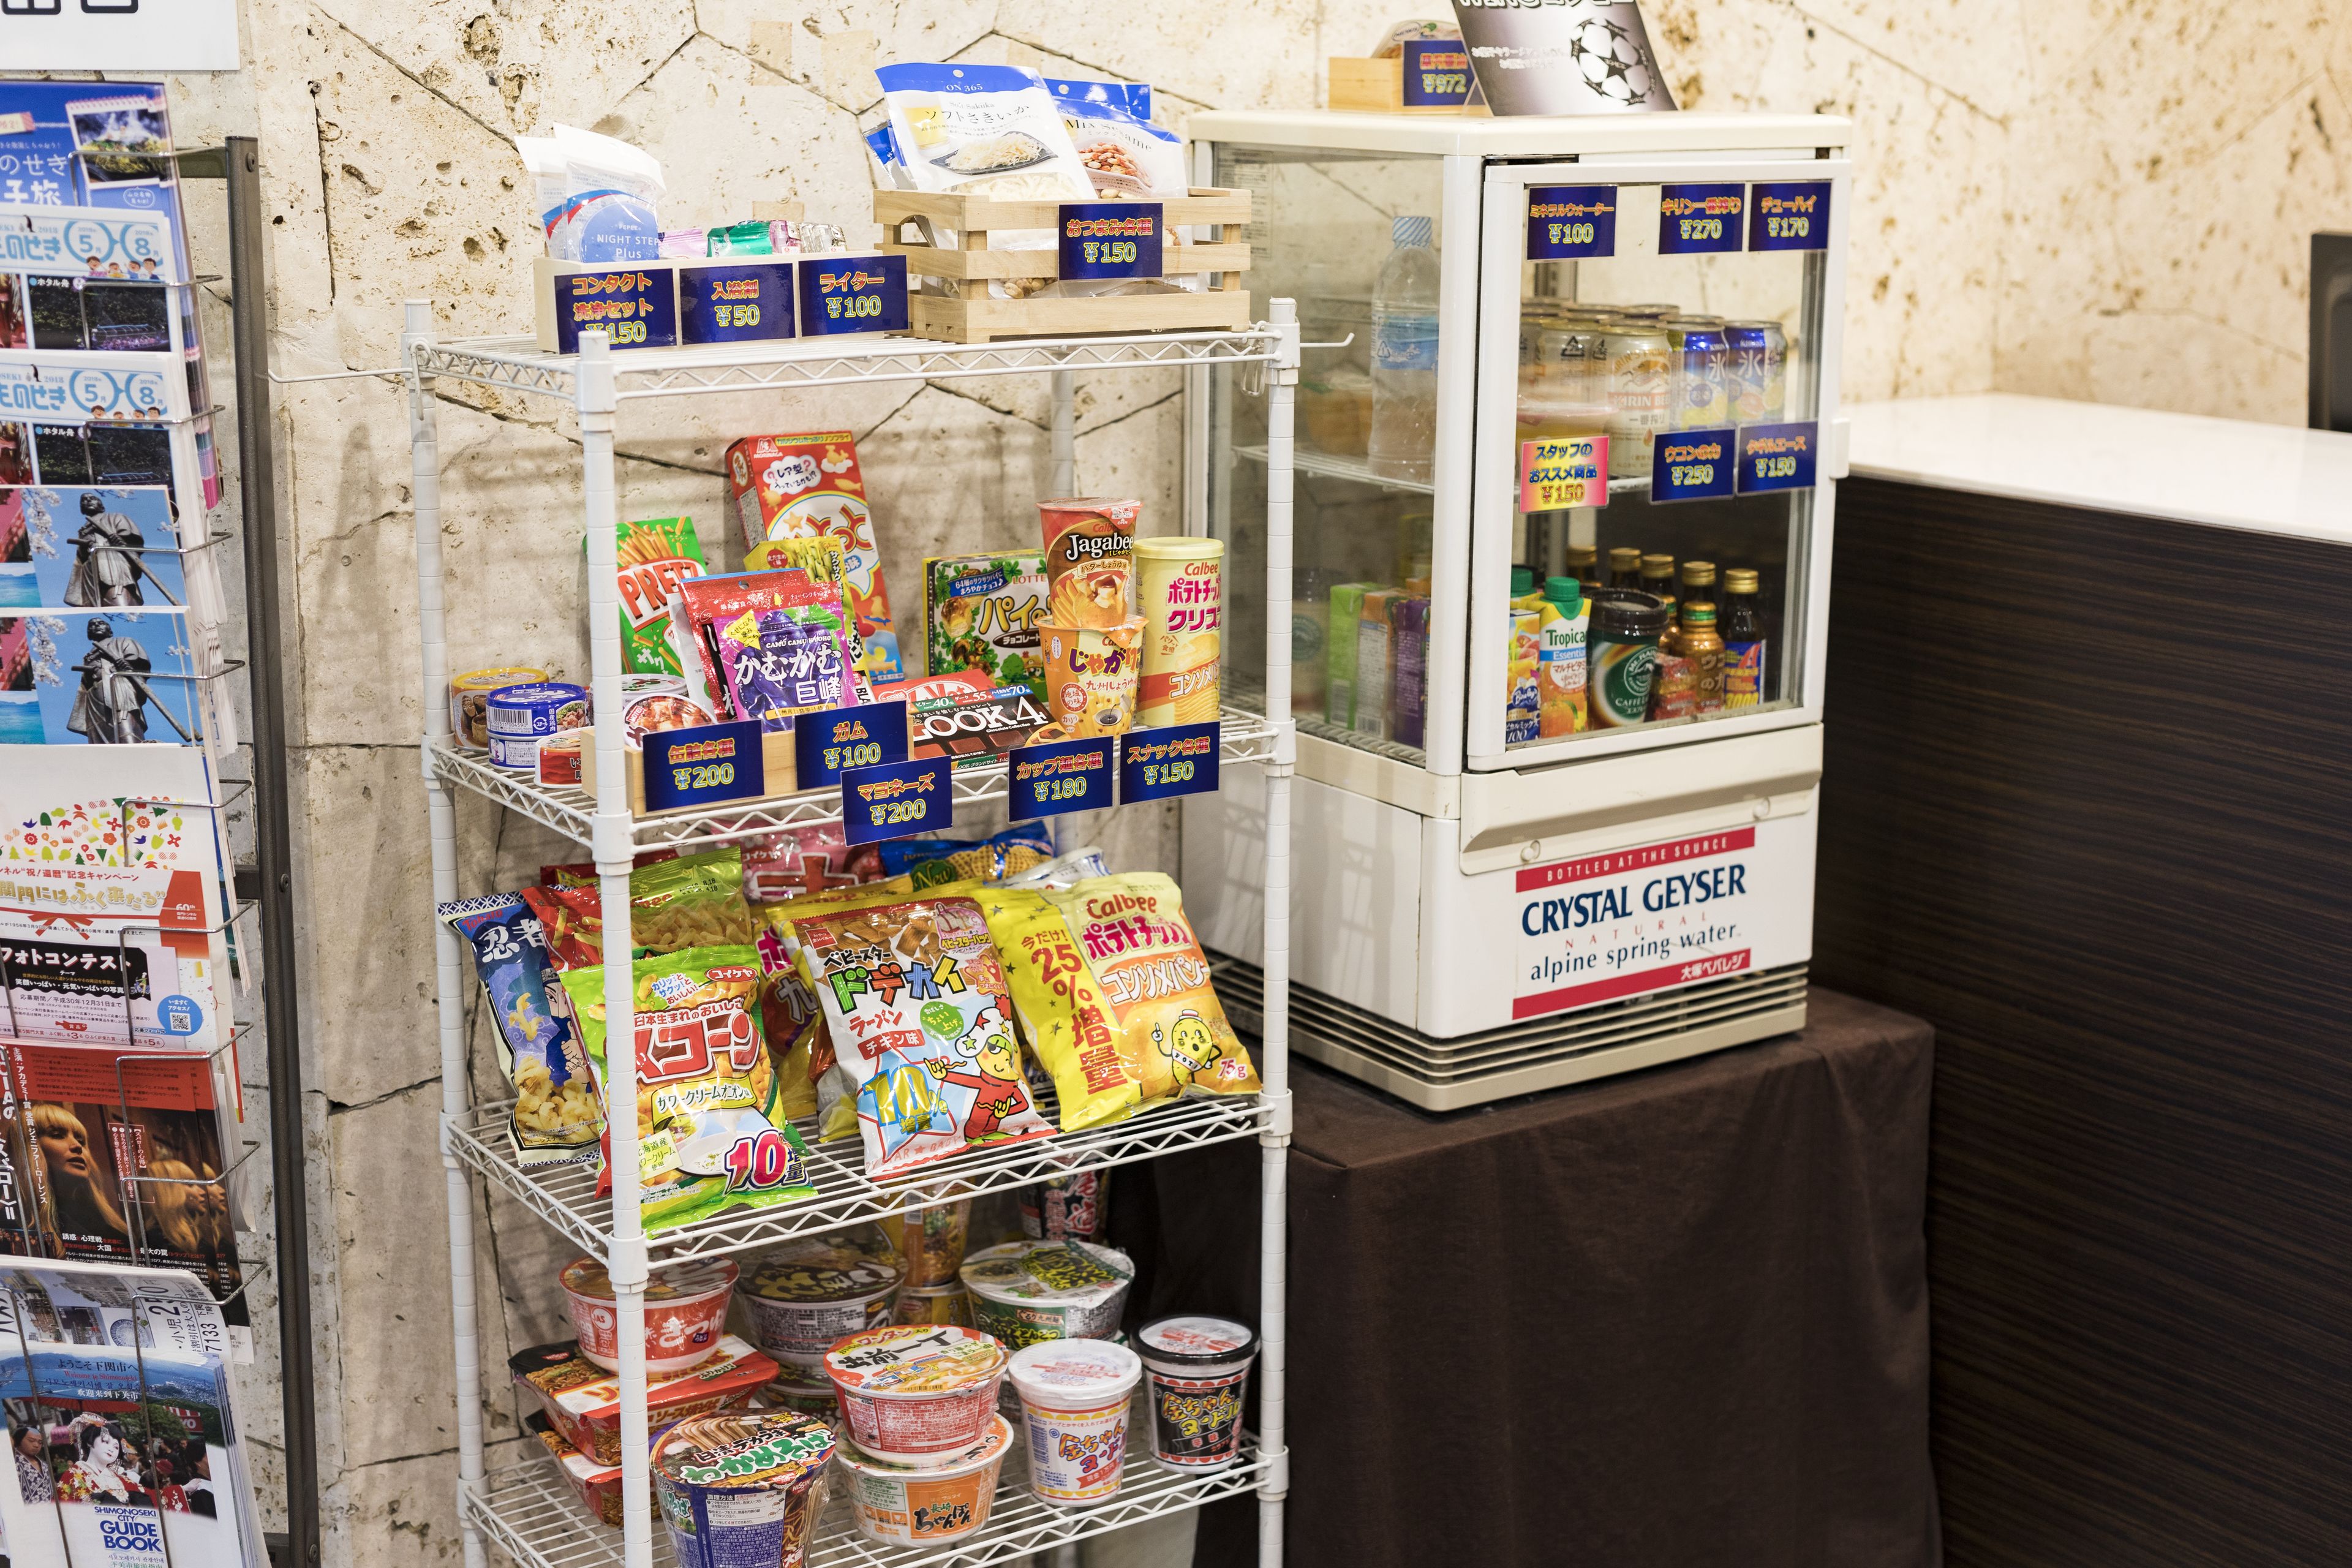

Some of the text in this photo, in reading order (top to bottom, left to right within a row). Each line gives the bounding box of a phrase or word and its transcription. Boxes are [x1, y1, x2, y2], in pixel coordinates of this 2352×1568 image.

[1529, 202, 1615, 219] ミネラルウォーター
[1761, 195, 1817, 214] チューハイ
[1066, 217, 1153, 238] おつまみ各種
[1548, 224, 1594, 244] ¥100
[1679, 219, 1722, 239] ¥270
[1767, 217, 1809, 238] ¥170
[597, 234, 659, 246] NIGHT STEP
[616, 247, 642, 258] Plus
[1084, 241, 1137, 263] ¥150
[572, 272, 652, 295] コンタクト
[711, 279, 759, 301] 入浴剤
[820, 271, 884, 293] ライター
[573, 298, 654, 322] 洗浄セット
[714, 304, 760, 327] ¥50
[826, 295, 882, 318] ¥100
[1534, 441, 1593, 461] スタッフの
[1529, 463, 1598, 483] おススメ商品
[1671, 465, 1714, 486] ¥250
[1755, 456, 1796, 478] ¥150
[1540, 483, 1585, 505] ¥150
[1066, 532, 1134, 560] Jagabee
[1012, 574, 1047, 585] LOTTE
[1184, 562, 1218, 576] Calbee
[766, 638, 786, 649] CAMU
[788, 637, 807, 647] CAMU
[733, 644, 843, 685] かむかむ
[796, 677, 842, 704] 巨峰
[913, 696, 1049, 741] LOOK 4
[832, 720, 869, 743] ガム
[668, 737, 736, 764] 缶詰各種
[823, 742, 881, 769] ¥100
[1127, 736, 1211, 764] スナック各種
[673, 763, 735, 791] ¥200
[1016, 751, 1104, 780] カップ麺各種
[1144, 760, 1194, 786] ¥150
[857, 772, 935, 802] マヨネーズ
[1034, 776, 1087, 802] ¥180
[870, 799, 927, 826] ¥200
[1547, 836, 1728, 883] BOTTLED AT THE SOURCE
[915, 865, 952, 889] New
[1086, 894, 1157, 919] Calbee
[1521, 864, 1746, 937] CRYSTAL GEYSER
[1566, 911, 1706, 949] NATURAL
[823, 945, 892, 968] ベビースター
[1531, 951, 1597, 983] alpine
[1606, 937, 1671, 968] spring
[1680, 952, 1746, 981] 大塚ベバレジ
[712, 968, 753, 979] コイケヤ
[826, 954, 967, 1015] ドデカイ
[865, 1031, 919, 1056] チキン味
[729, 1133, 788, 1188] 10
[837, 1330, 951, 1370] 出前一丁
[680, 1428, 836, 1485] わかめそば
[94, 1506, 157, 1517] SHIMONOSEKI
[913, 1502, 973, 1533] ちゃんぽん
[100, 1520, 157, 1537] GUIDE
[104, 1535, 162, 1552] BOOK
